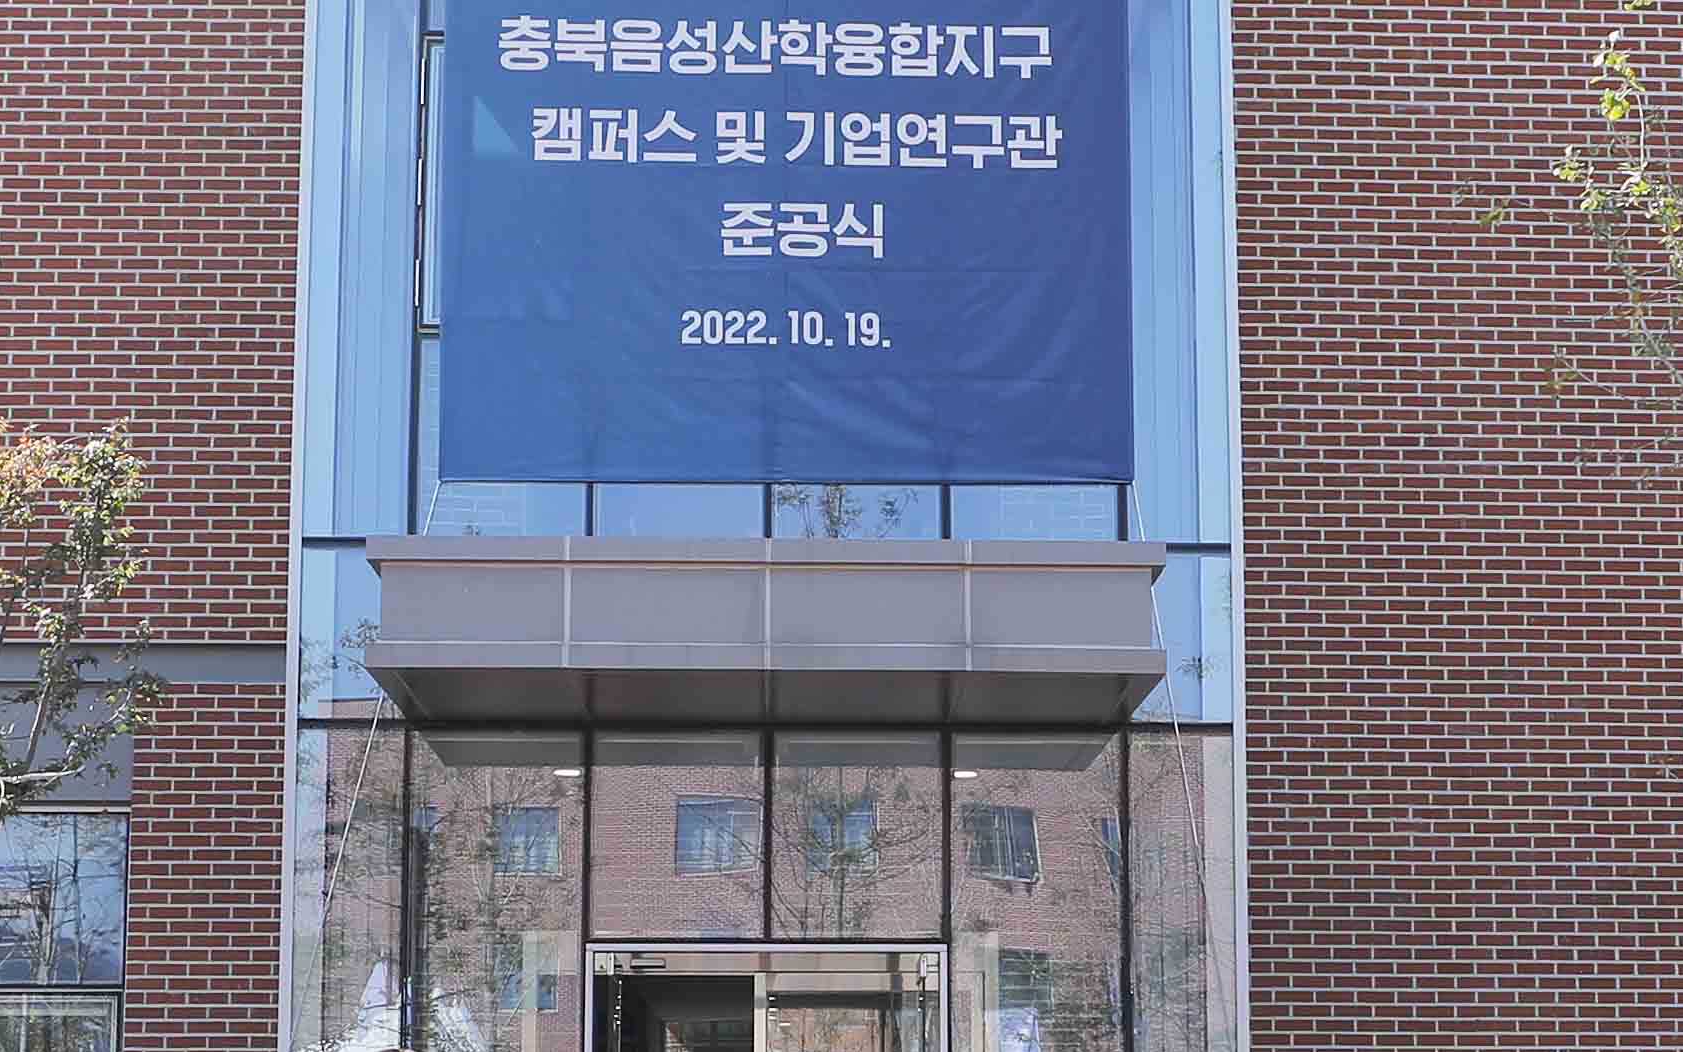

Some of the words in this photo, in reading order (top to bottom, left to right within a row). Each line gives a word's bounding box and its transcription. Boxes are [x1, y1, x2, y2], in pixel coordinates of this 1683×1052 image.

[498, 15, 1053, 79] 충북음성산학융합지구
[531, 107, 697, 163] 캠퍼스
[715, 110, 767, 164] 및
[784, 111, 1063, 169] 기업연구관
[720, 202, 884, 259] 준공식
[681, 310, 778, 345] 2022.
[788, 310, 834, 347] 10.
[844, 312, 891, 348] 19.
